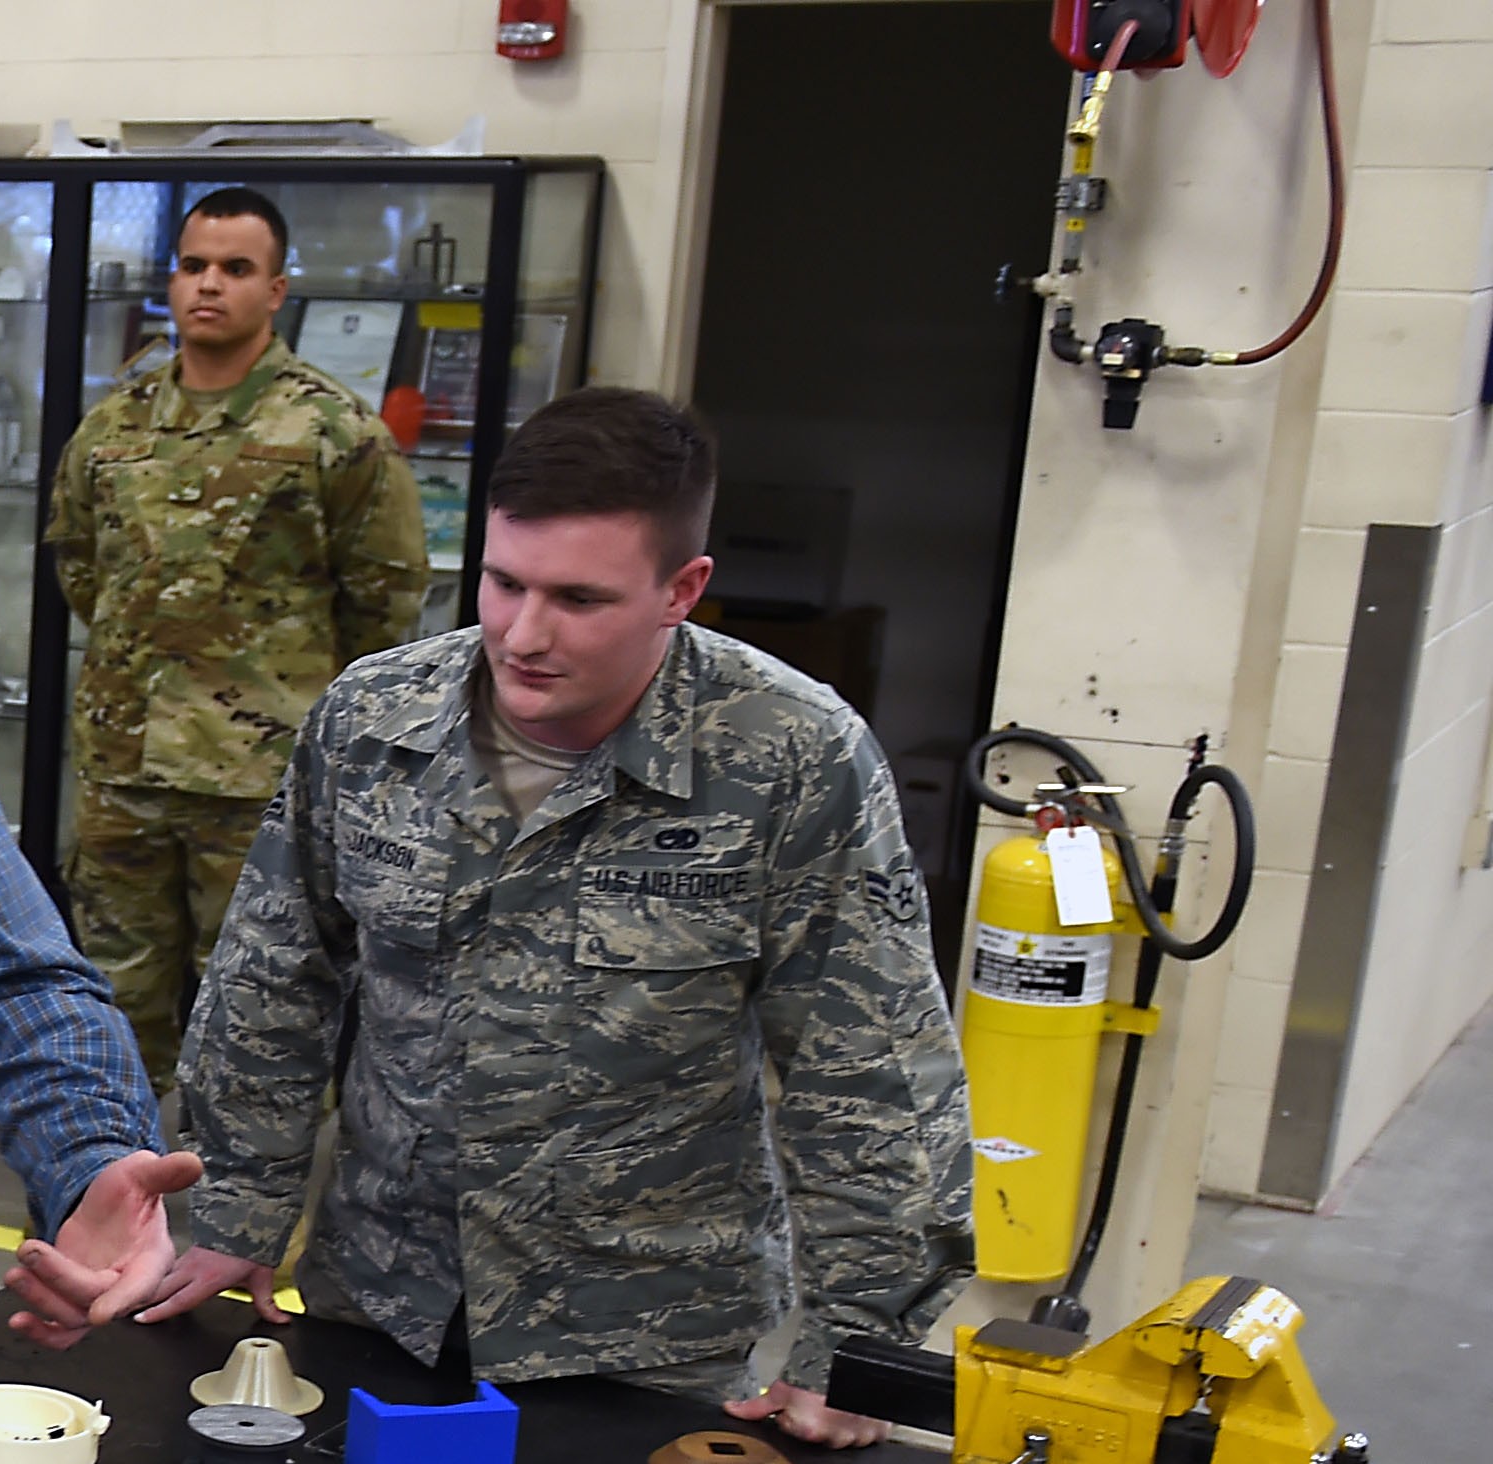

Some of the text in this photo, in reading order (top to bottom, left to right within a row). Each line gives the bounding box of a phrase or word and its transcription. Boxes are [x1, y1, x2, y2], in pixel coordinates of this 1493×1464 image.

[347, 831, 417, 872] JACKSON
[635, 871, 672, 897] AIR
[673, 871, 750, 897] FORCE
